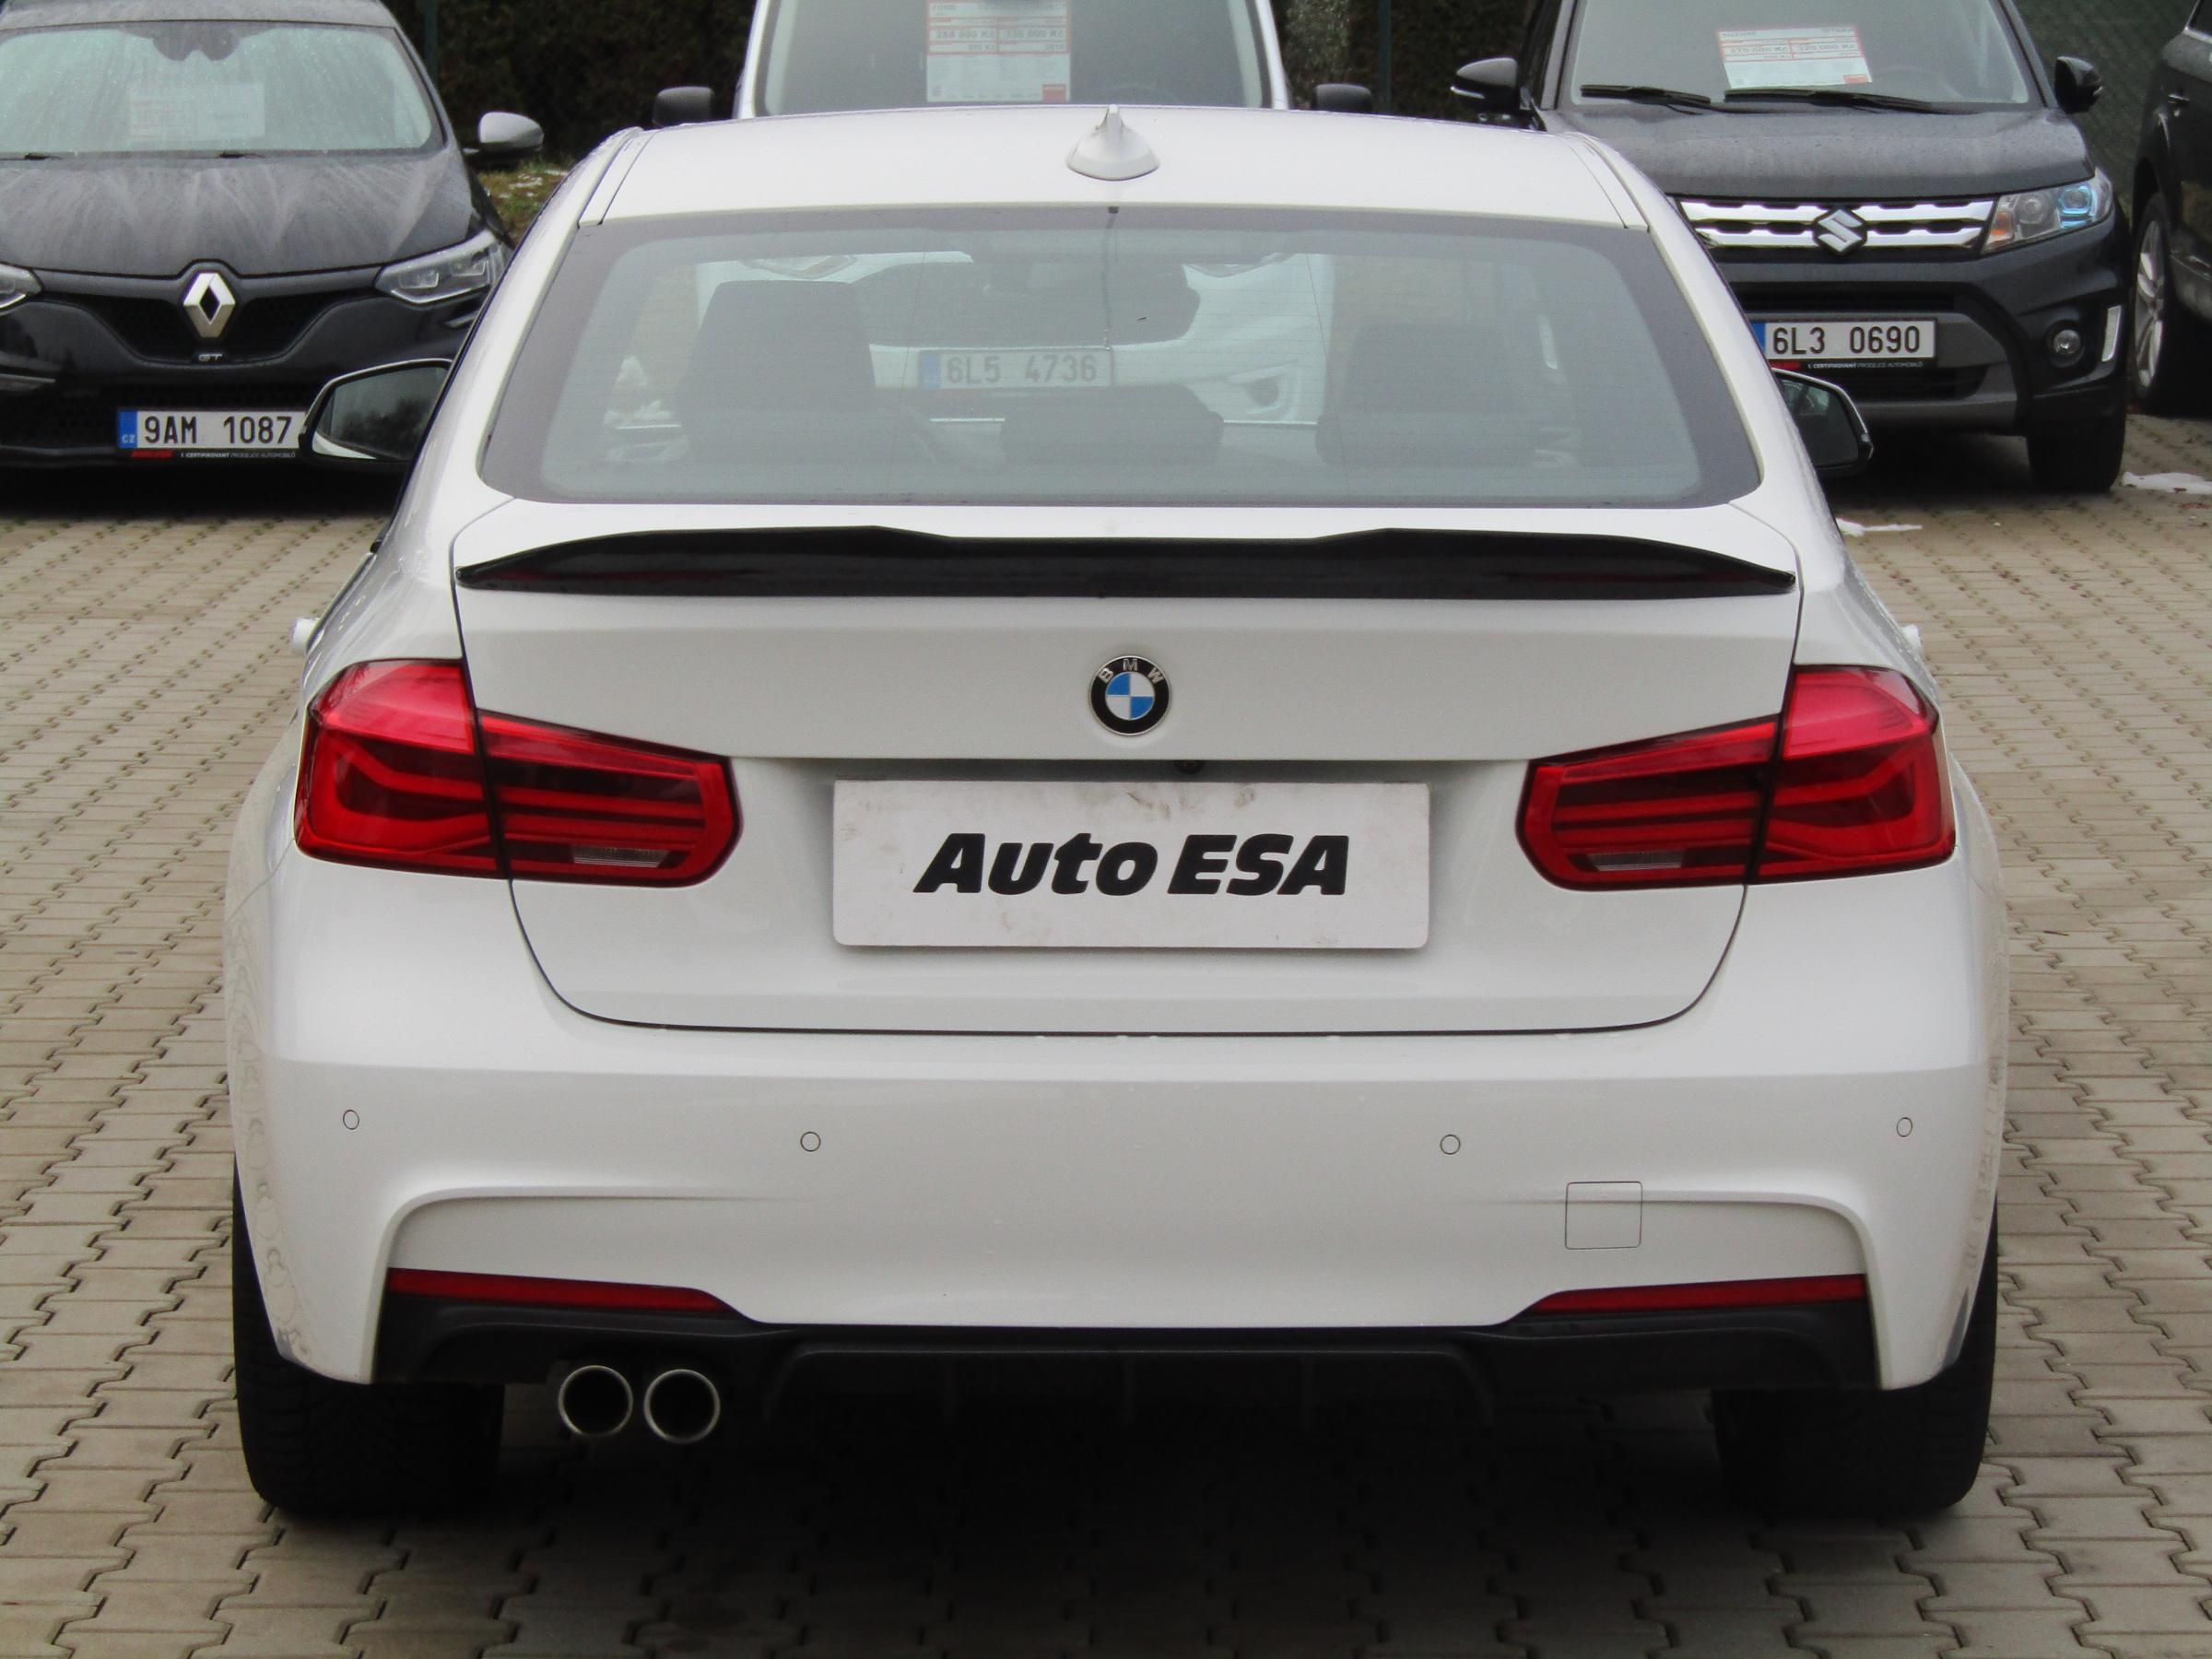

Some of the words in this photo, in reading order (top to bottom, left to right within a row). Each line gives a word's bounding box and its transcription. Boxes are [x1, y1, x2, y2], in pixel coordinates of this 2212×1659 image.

[1772, 326, 1826, 355] 6L3
[1849, 324, 1921, 354] 0690
[198, 353, 223, 361] GT
[947, 355, 1001, 383] 6L5
[1024, 353, 1097, 382] 4736
[122, 434, 136, 443] CZ
[144, 416, 197, 444] 9AM
[222, 416, 293, 444] 1087
[1097, 658, 1164, 684] BMW
[912, 833, 1159, 897] Auto
[1167, 833, 1350, 897] ESA
